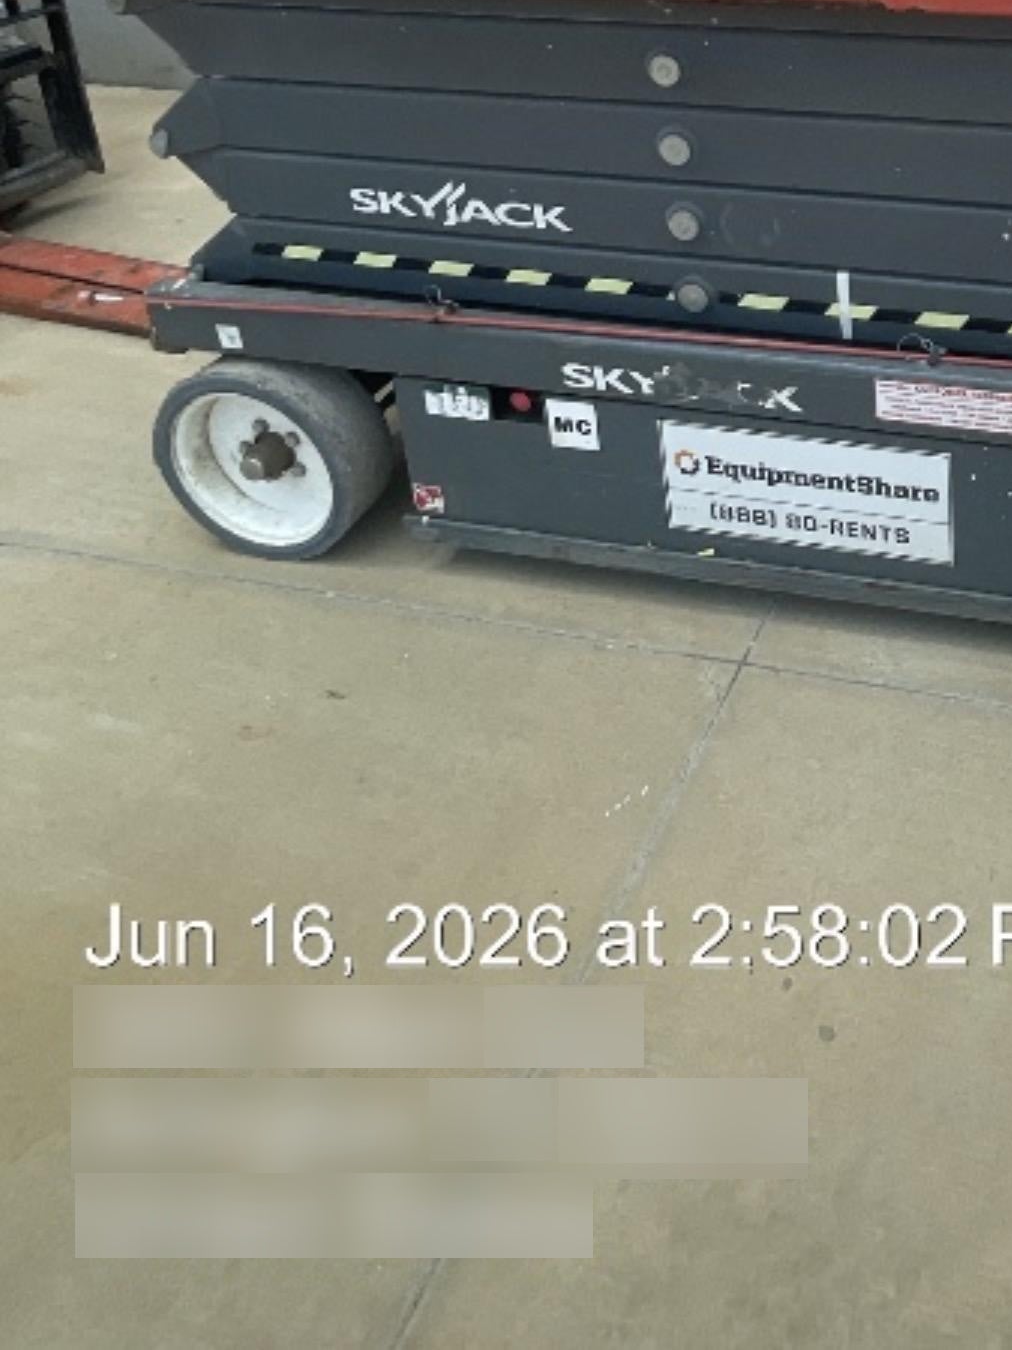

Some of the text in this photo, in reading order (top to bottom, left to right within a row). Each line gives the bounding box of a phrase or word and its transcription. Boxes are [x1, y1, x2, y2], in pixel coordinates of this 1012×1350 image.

[350, 181, 572, 233] SKYJACK
[704, 455, 940, 502] EquipmentShare
[786, 512, 911, 544] 80-RENTS
